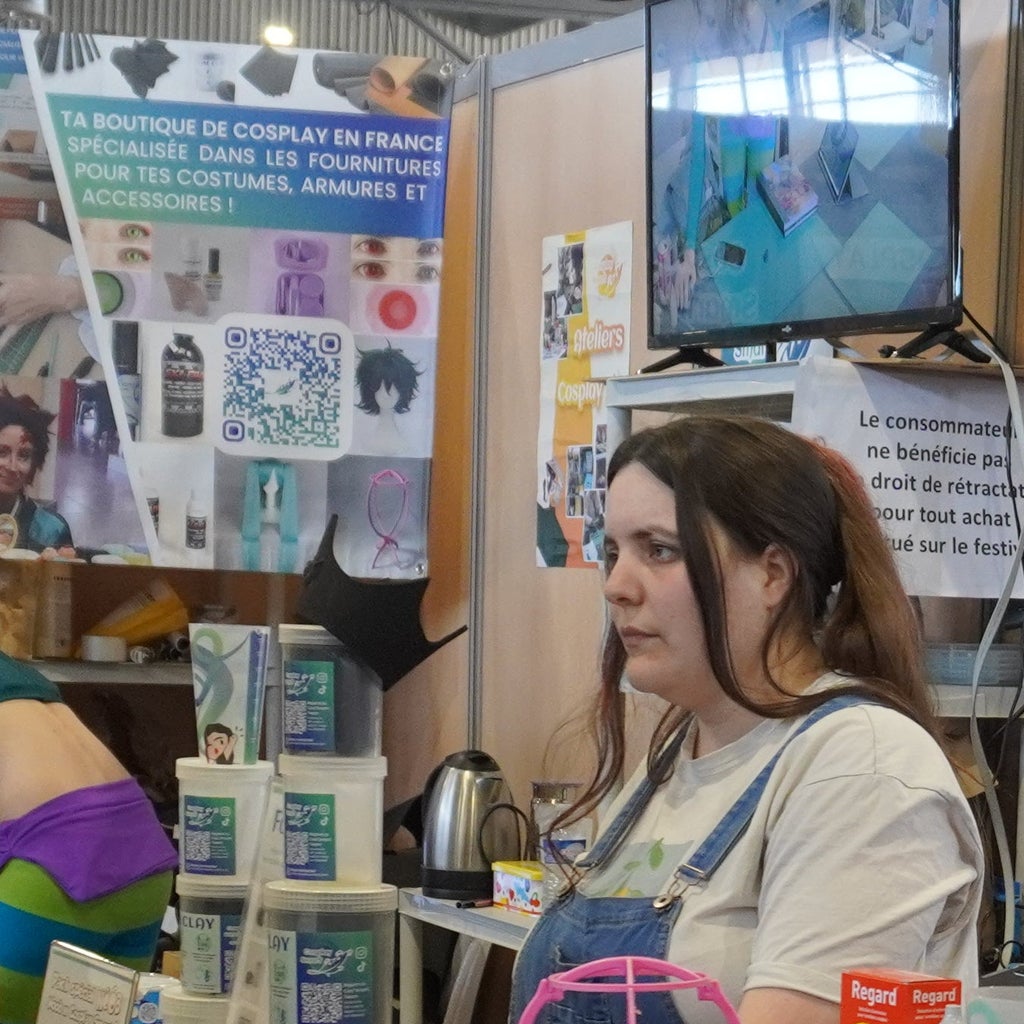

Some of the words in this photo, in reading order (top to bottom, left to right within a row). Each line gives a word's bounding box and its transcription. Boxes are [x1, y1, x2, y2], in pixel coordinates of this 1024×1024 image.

[61, 111, 87, 128] TA
[93, 113, 196, 136] BOUTIQUE
[202, 121, 227, 137] DE
[233, 122, 328, 144] COSPLAY
[334, 129, 359, 146] EN
[365, 131, 443, 152] FRANCE
[67, 134, 188, 160] SPÉCIALISÉE
[199, 145, 255, 164] DANS
[266, 150, 297, 167] LES
[309, 153, 441, 177] FOURNITURES
[75, 163, 130, 182] POUR
[137, 167, 170, 184] TES
[177, 169, 293, 194] COSTUMES,
[301, 177, 396, 199] ARMURES
[406, 184, 427, 201] ET
[82, 188, 221, 212] ACCESSOIRES
[228, 197, 233, 213] !
[557, 381, 603, 410] Cosplay
[859, 410, 880, 428] Le
[867, 444, 890, 459] ne
[897, 442, 977, 466] bénéficie
[871, 472, 917, 491] droit
[922, 475, 942, 493] de
[920, 507, 956, 524] tout
[963, 509, 1011, 527] achat
[920, 540, 946, 554] sur
[952, 537, 968, 555] le
[182, 915, 215, 930] CLAY
[268, 934, 290, 951] LAY
[851, 980, 898, 1006] Regard
[913, 987, 957, 1006] Regard
